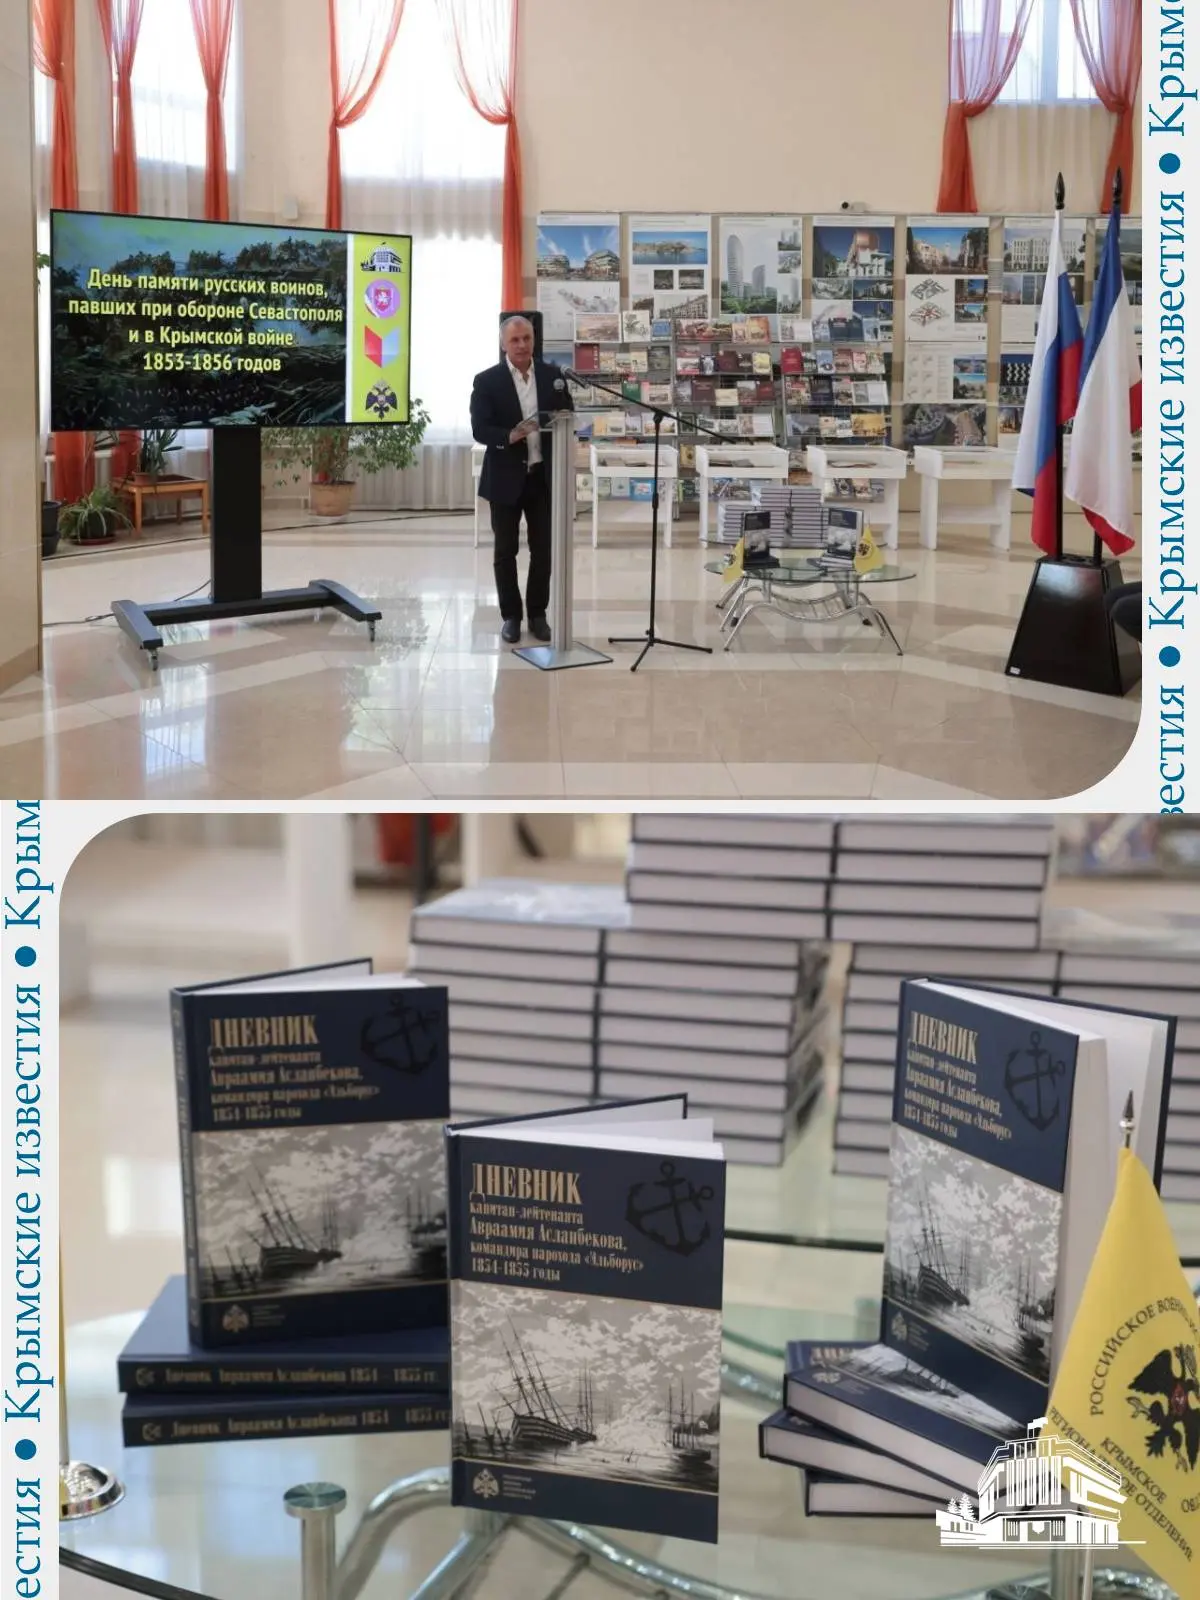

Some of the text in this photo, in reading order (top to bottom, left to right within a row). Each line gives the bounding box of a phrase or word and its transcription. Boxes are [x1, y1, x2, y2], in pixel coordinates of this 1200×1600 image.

[88, 268, 328, 299] День памяти русских воинов,
[69, 300, 343, 322] павших при обороне Севастополя
[128, 326, 294, 348] и в Крымской войне
[143, 352, 281, 374] 1853-1856 годов
[208, 1014, 319, 1052] ДНЕВНИК
[908, 1011, 978, 1065] ДНЕВНИК
[469, 1162, 583, 1205] ДНЕВНИК
[469, 1201, 584, 1225] капитан-лейтенанта
[469, 1215, 628, 1251] Авраамия Асланбекова,
[470, 1241, 529, 1261] командира
[532, 1247, 581, 1265] парохода
[533, 1266, 561, 1281] годы
[1090, 1304, 1156, 1416] РОССИЙСКОЕ
[1101, 1437, 1167, 1504] КРЫМСКОЕ
